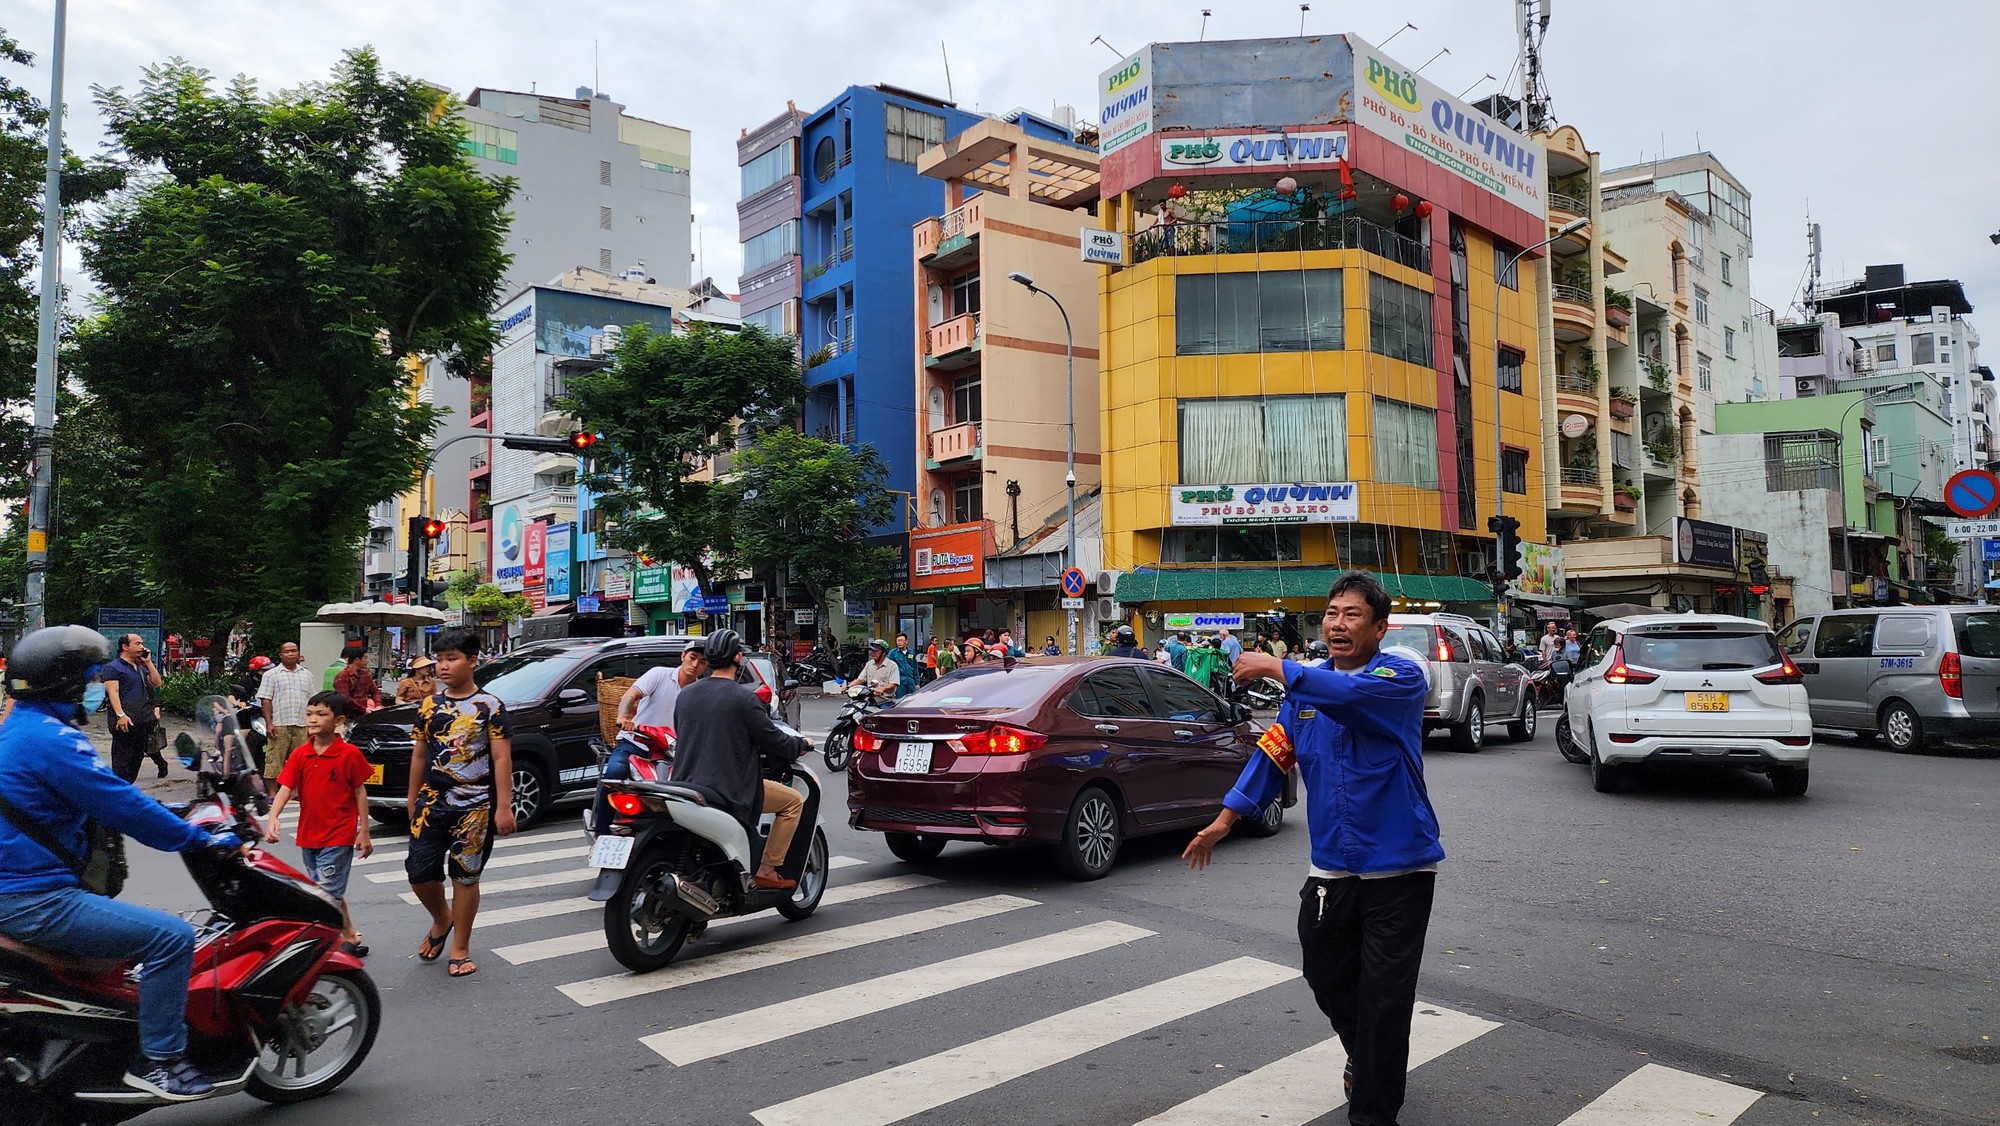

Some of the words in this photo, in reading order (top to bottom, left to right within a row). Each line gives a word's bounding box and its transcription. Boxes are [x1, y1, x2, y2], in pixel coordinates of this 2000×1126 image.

[1109, 57, 1141, 91] PHỞ
[1367, 56, 1418, 105] PHỞ
[1102, 86, 1148, 124] QUỲNH
[1170, 137, 1220, 159] PHỞ
[1363, 96, 1387, 117] PHỞ
[1389, 111, 1405, 127] BÒ
[1412, 123, 1427, 139] BÒ
[1430, 133, 1453, 153] KHO
[1459, 149, 1480, 167] PHỞ
[1481, 161, 1495, 177] GÀ
[1501, 172, 1524, 192] MIẾN
[1525, 186, 1538, 200] GÀ
[1431, 98, 1535, 179] QUỲNH
[1087, 247, 1120, 260] QUỲNH
[1181, 486, 1233, 503] PHỞ
[1244, 483, 1352, 504] QUỲNH
[1202, 504, 1232, 516] PHỞ
[1236, 504, 1256, 515] BÒ
[1271, 503, 1291, 514] BÒ
[1296, 505, 1329, 514] KHO
[1881, 658, 1913, 668] 57M-3615
[1697, 693, 1716, 702] 51H
[906, 744, 924, 758] 51H
[898, 758, 928, 772] 159.58
